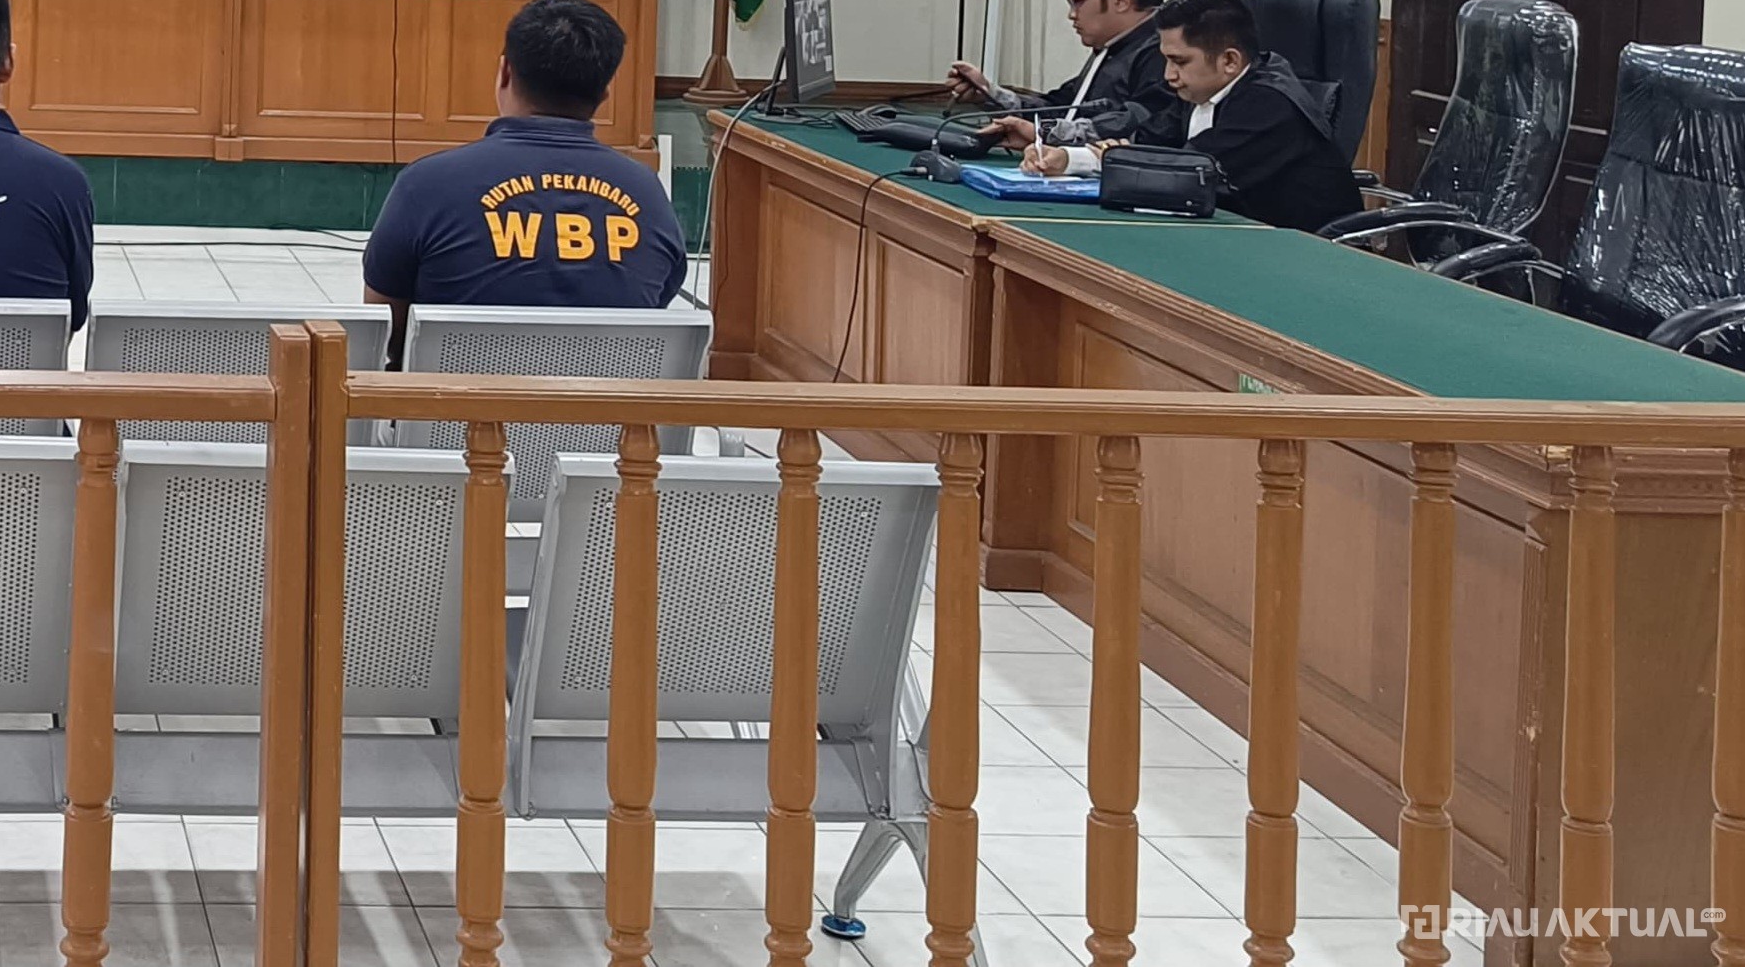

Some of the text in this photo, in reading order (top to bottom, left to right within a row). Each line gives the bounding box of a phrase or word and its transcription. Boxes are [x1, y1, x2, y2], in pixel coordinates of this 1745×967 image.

[480, 173, 641, 217] RUTAN PEKANBARU
[484, 210, 640, 262] WBP
